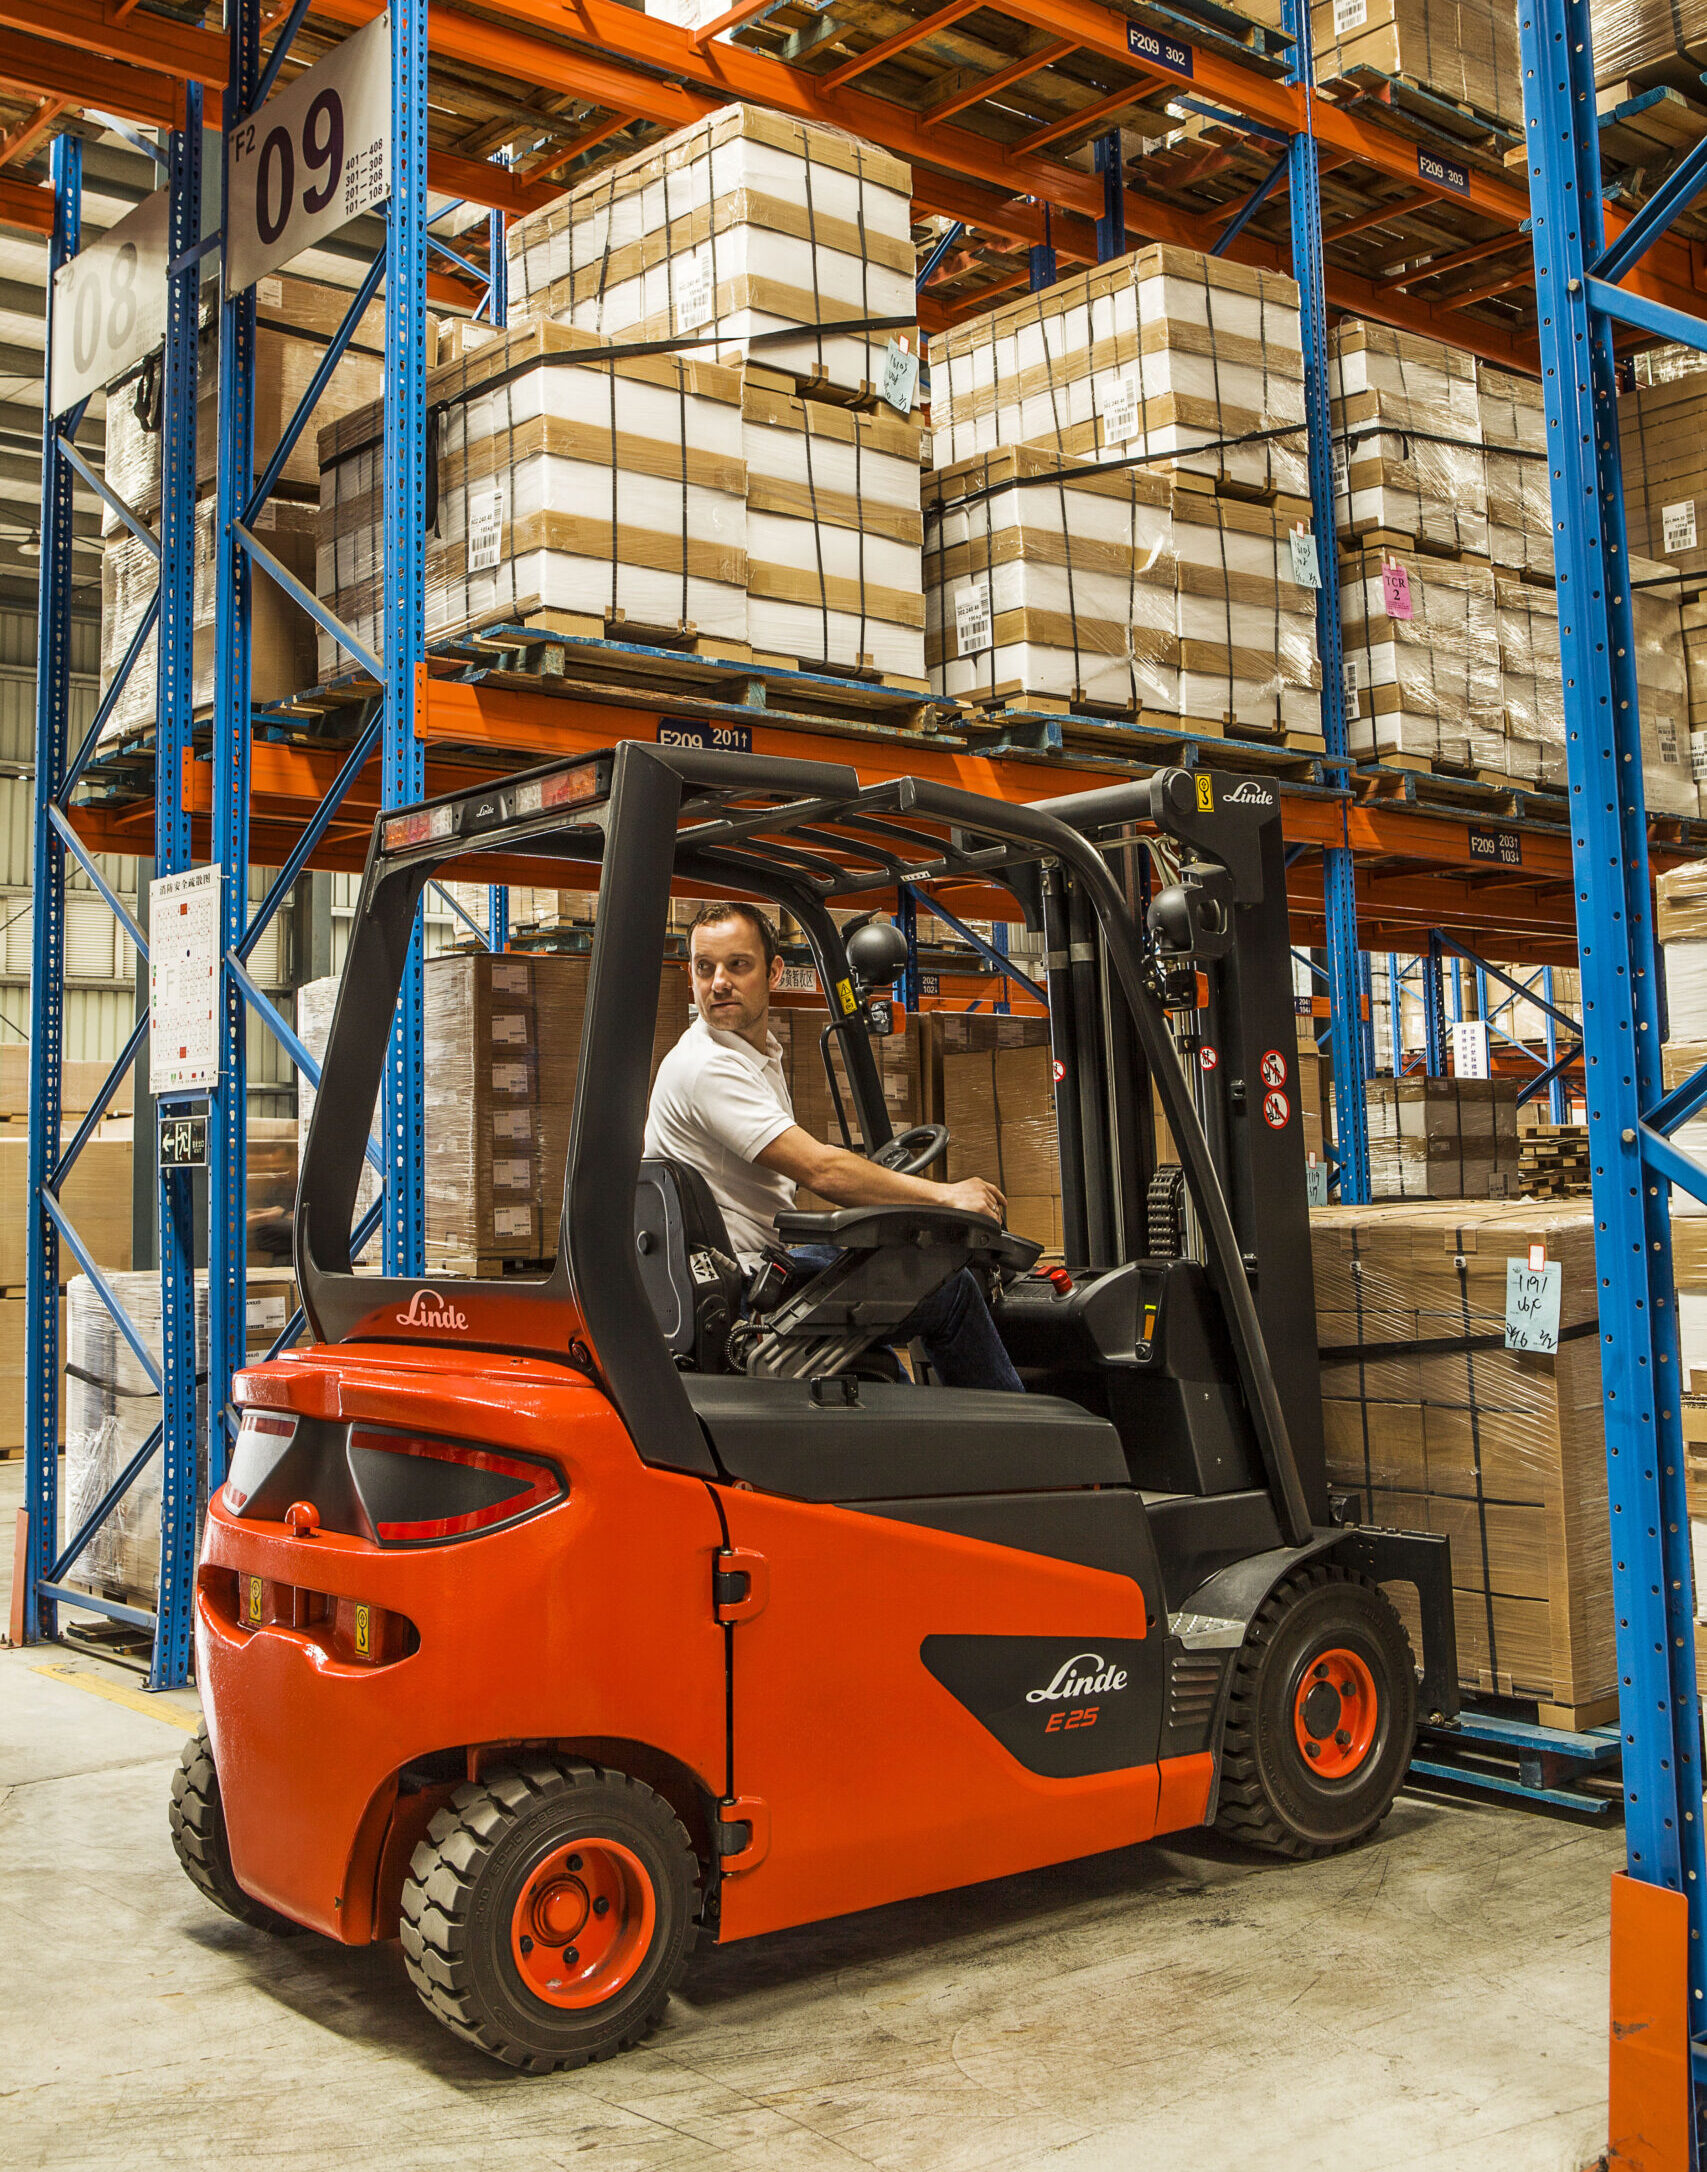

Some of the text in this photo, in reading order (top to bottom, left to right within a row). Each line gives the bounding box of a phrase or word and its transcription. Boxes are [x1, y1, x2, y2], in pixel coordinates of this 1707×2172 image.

[1130, 29, 1186, 67] F209 302
[235, 124, 256, 163] F2
[256, 88, 344, 244] 09
[1420, 156, 1464, 186] F209 303
[73, 241, 138, 375] 08
[1385, 576, 1406, 589] TCR
[1392, 589, 1401, 601] 2
[712, 728, 740, 747] 201
[1222, 781, 1273, 805] Linde
[475, 804, 495, 818] Linde
[1471, 834, 1515, 854] F209 203
[1500, 849, 1516, 863] 103
[396, 1288, 469, 1330] Linde
[1025, 1653, 1128, 1703] Linde
